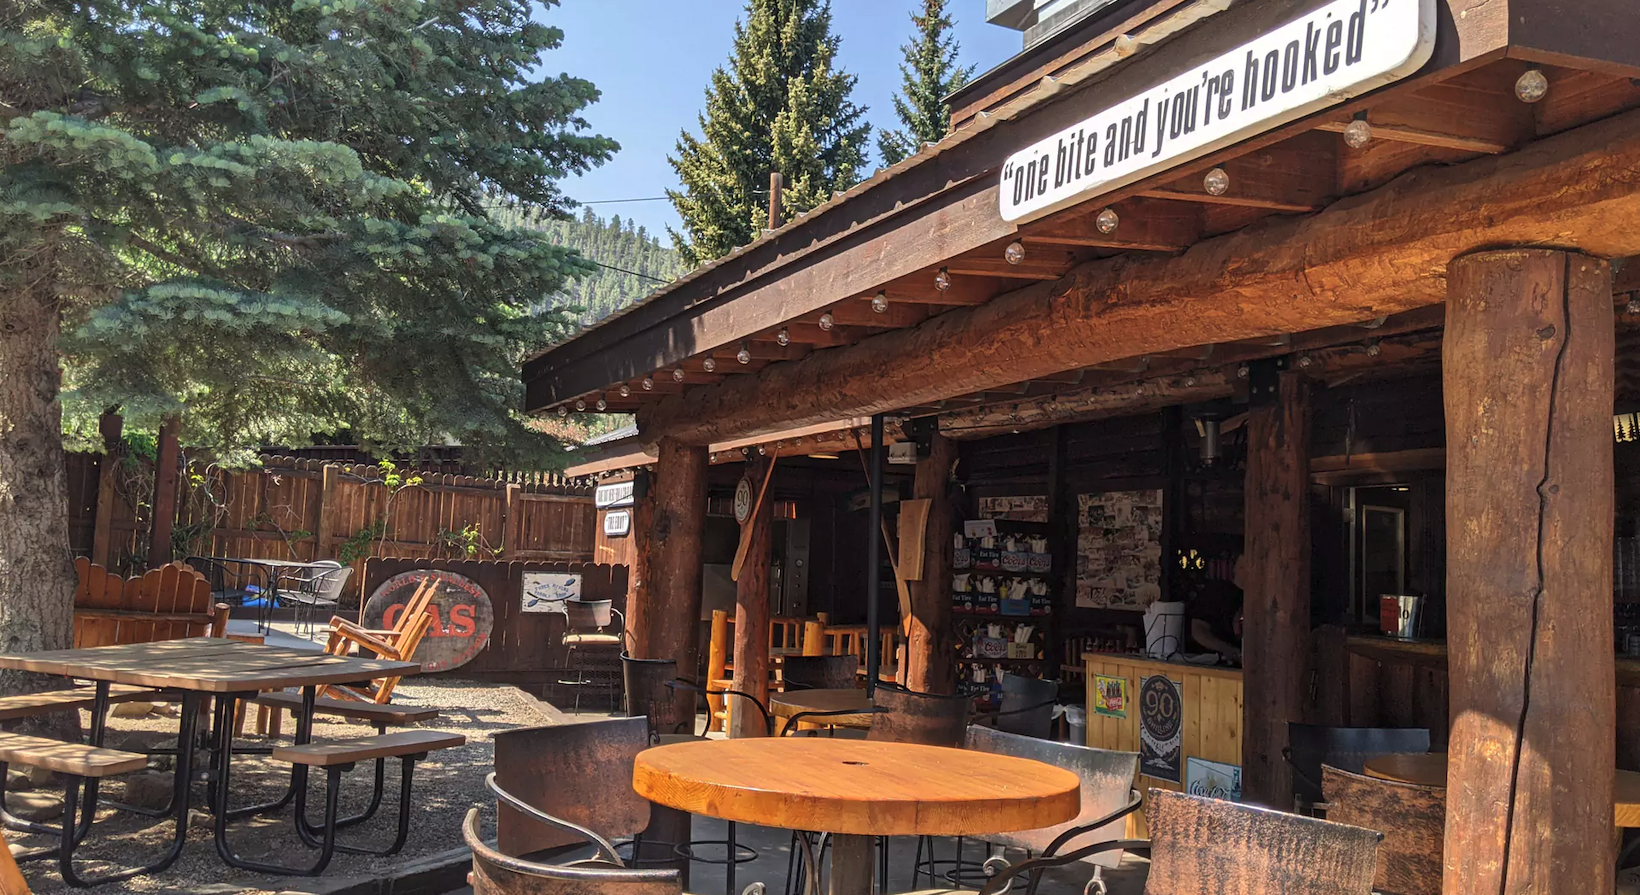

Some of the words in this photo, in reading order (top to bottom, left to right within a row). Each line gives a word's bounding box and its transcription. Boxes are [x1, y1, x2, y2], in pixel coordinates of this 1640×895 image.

[1054, 129, 1098, 189] bite
[1103, 98, 1149, 168] and
[1152, 69, 1234, 158] you’re
[1002, 554, 1025, 565] Coors
[1029, 556, 1049, 567] Coors
[984, 641, 1007, 652] Coors
[1146, 690, 1173, 718] 90
